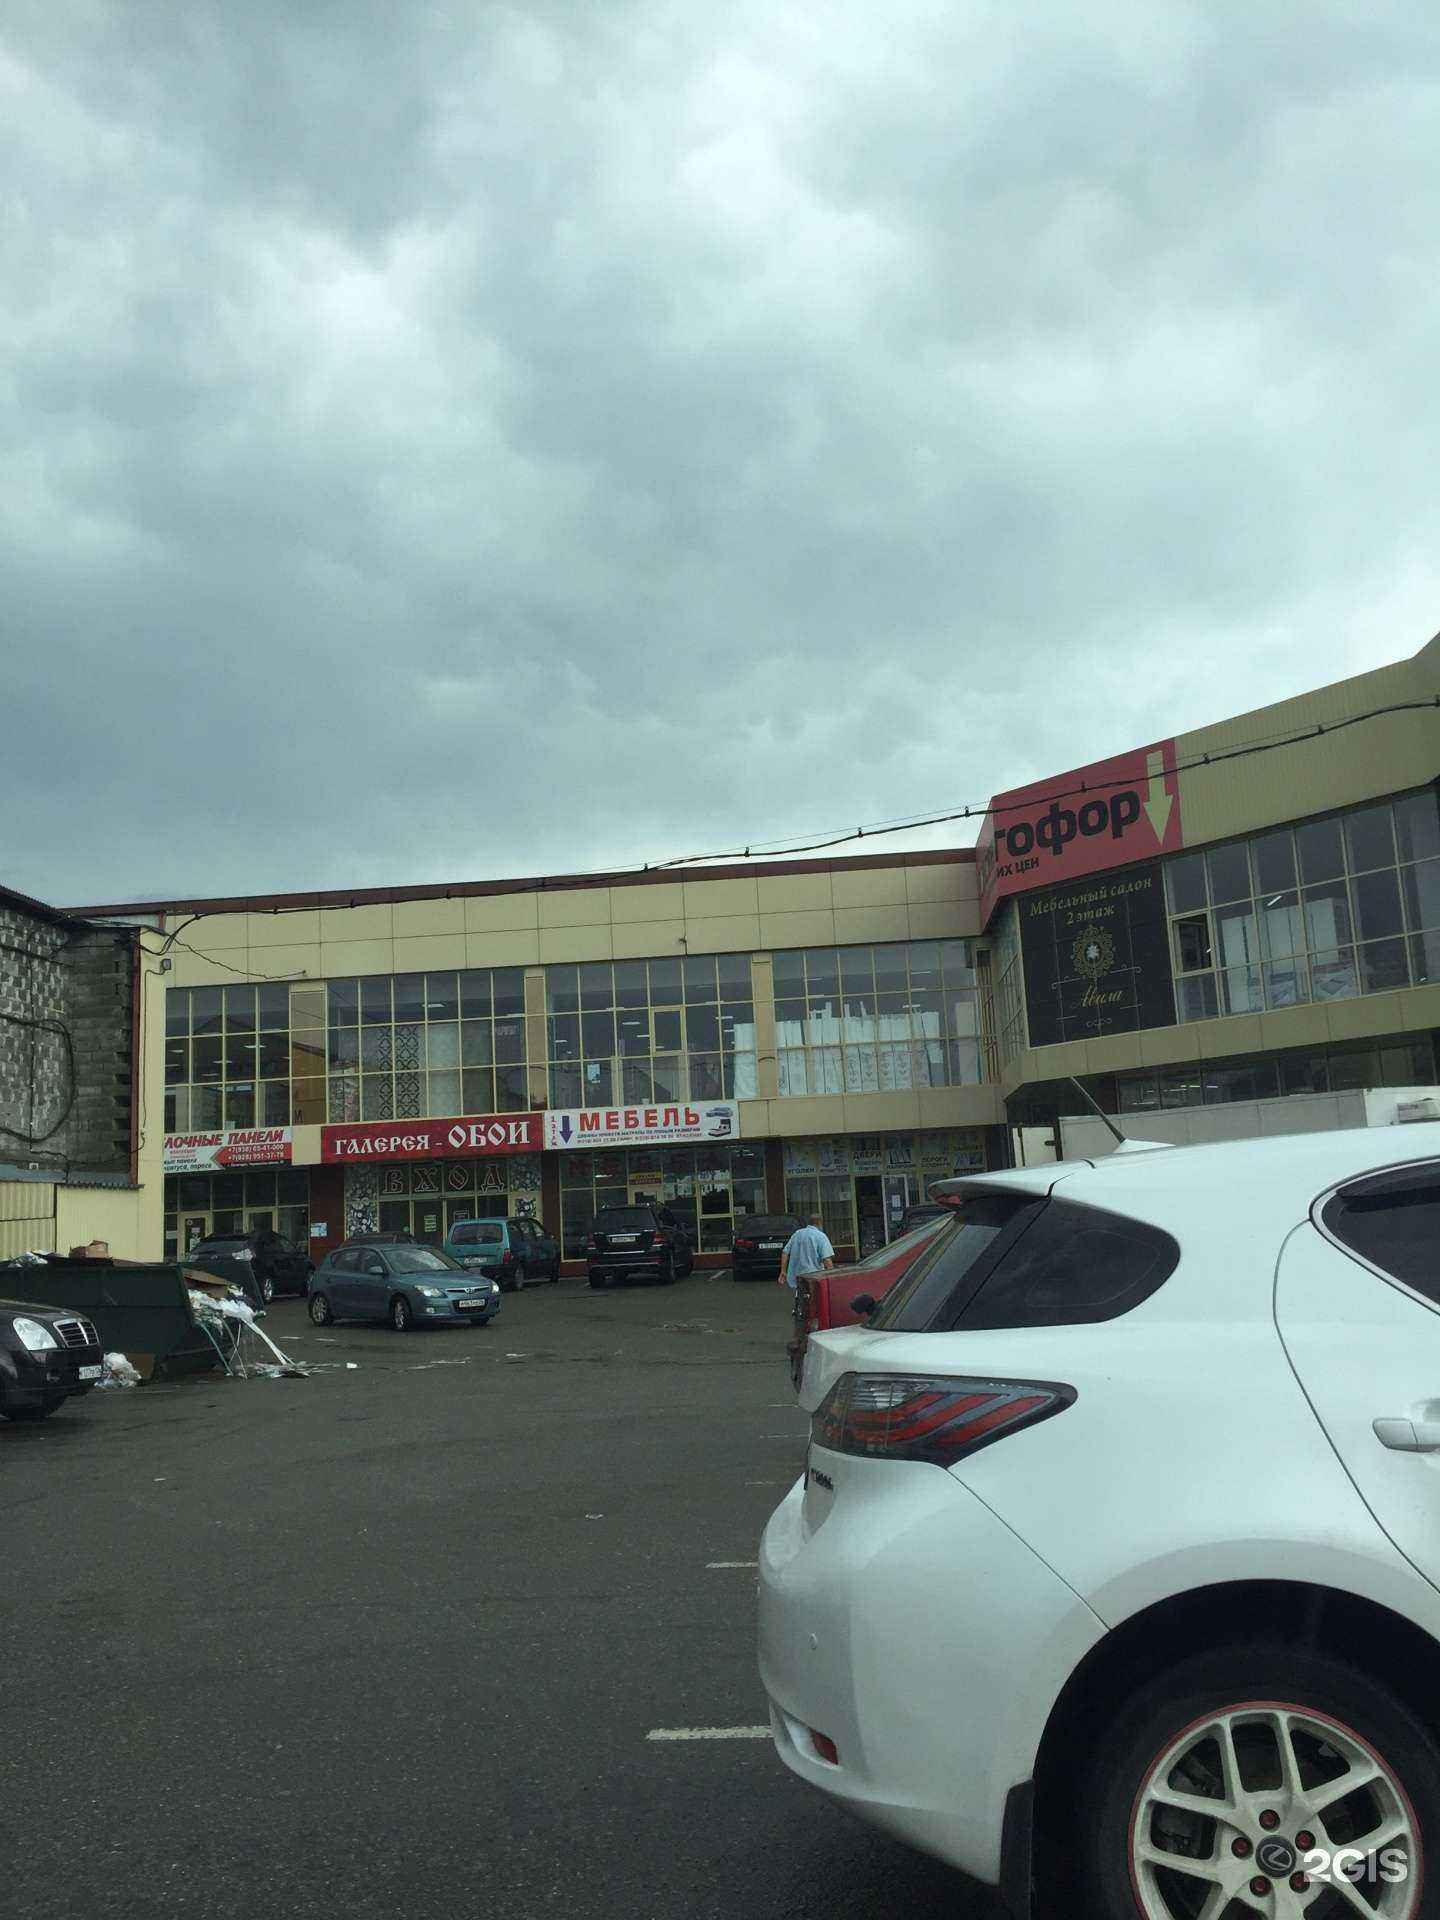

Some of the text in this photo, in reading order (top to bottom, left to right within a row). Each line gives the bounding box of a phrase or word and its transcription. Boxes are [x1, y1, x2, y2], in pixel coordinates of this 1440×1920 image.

[1015, 857, 1040, 874] ЦЕН
[1030, 878, 1152, 917] Мебельный салон
[1066, 904, 1115, 924] 2 этаж
[579, 1107, 700, 1131] МЕБЕЛЬ
[164, 1129, 284, 1149] ЛОЧНЫЕ ПАНЕЛИ
[335, 1134, 431, 1155] ГАЛЕРЕЯ
[447, 1121, 531, 1149] ОБОИ
[382, 1164, 505, 1194] ВХОД
